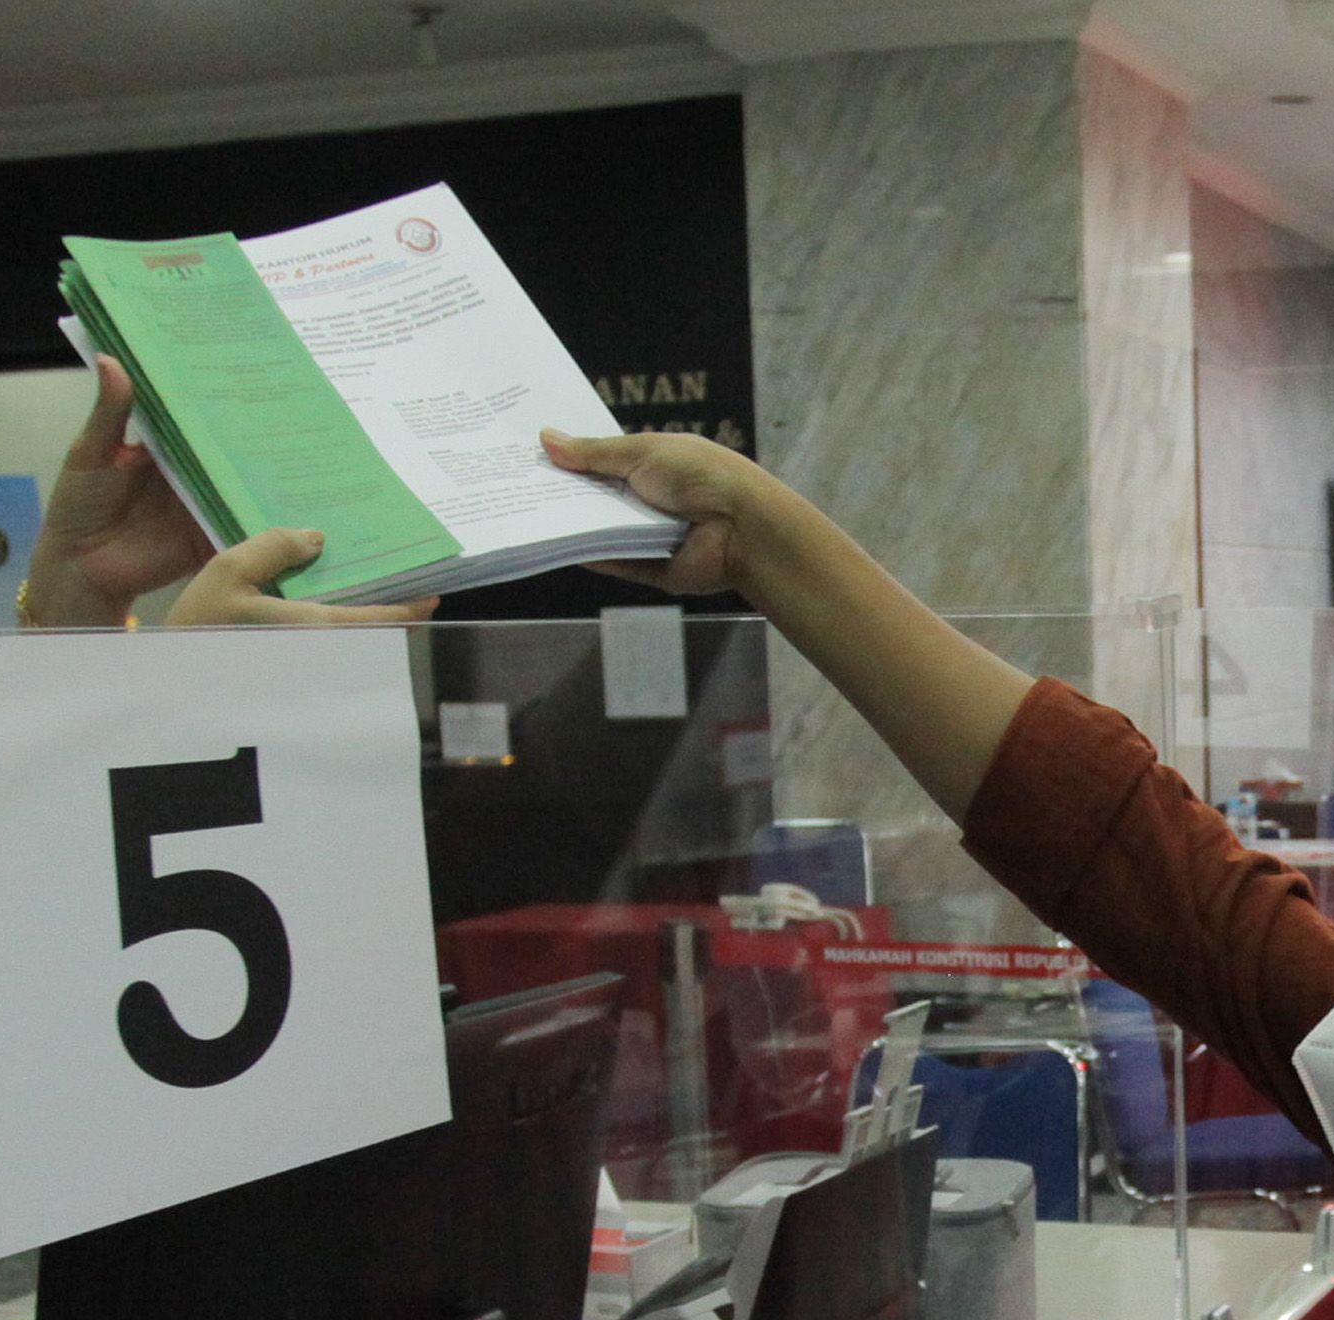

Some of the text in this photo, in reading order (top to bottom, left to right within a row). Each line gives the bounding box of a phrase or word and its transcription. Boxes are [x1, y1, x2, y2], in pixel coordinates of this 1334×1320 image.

[318, 235, 373, 257] HUKUM
[311, 252, 376, 277] Partners
[108, 745, 292, 1089] 5
[823, 947, 912, 965] MAHKAMAH
[916, 949, 1009, 969] KONSTITUSI
